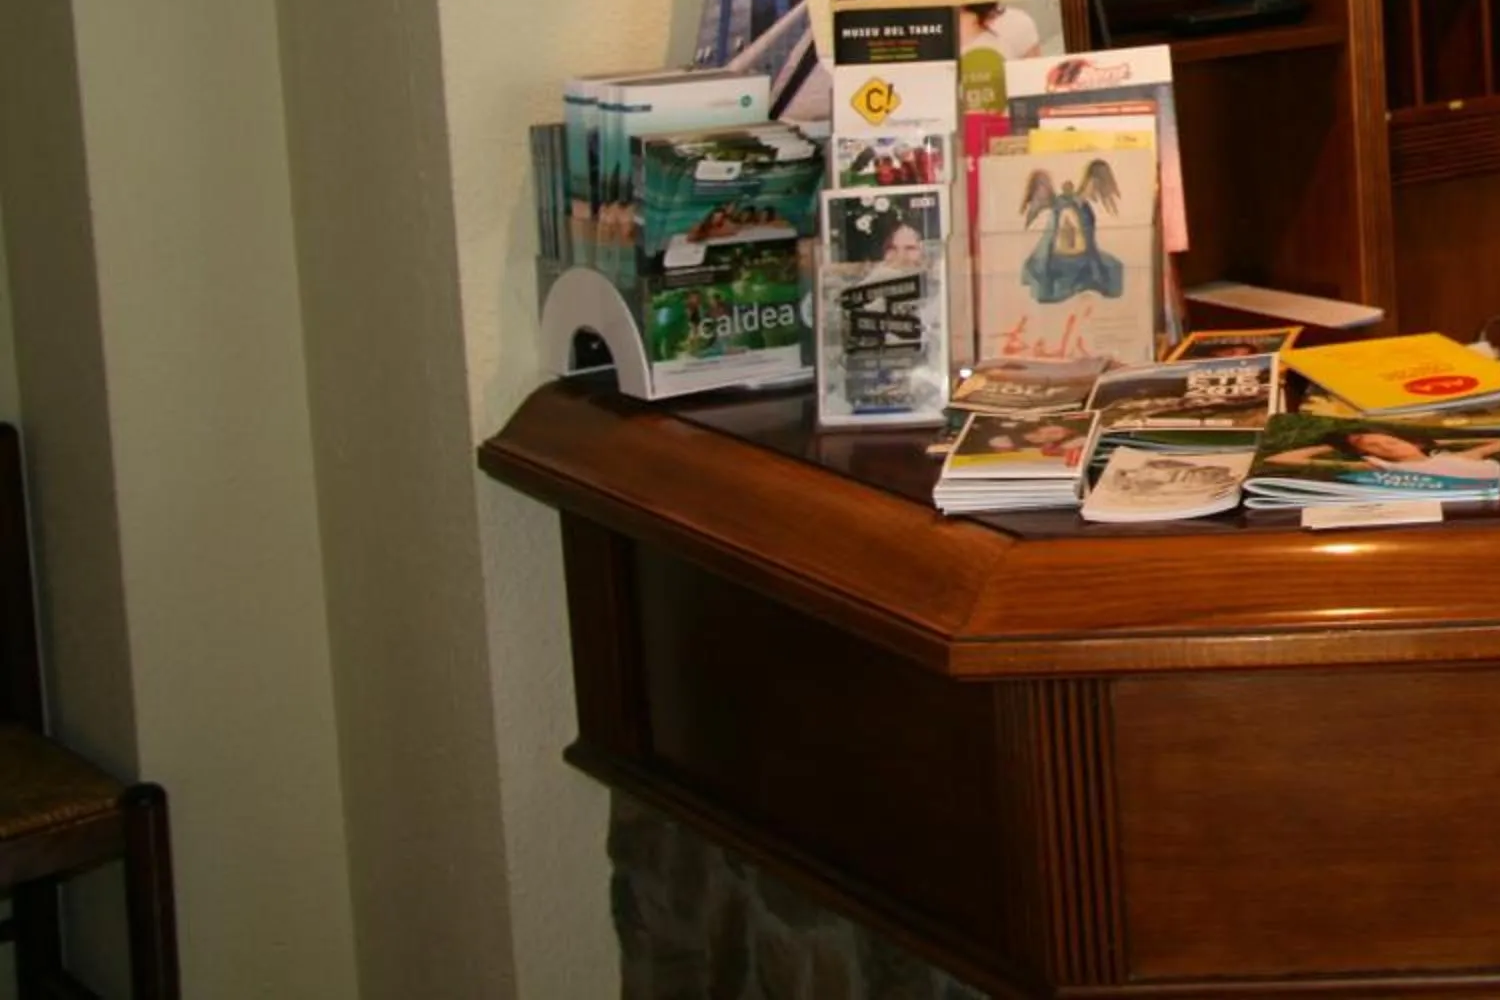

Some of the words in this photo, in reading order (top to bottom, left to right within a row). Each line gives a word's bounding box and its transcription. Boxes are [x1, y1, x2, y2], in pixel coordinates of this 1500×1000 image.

[842, 27, 880, 37] MUSEU
[883, 25, 906, 36] DEL
[700, 302, 796, 340] caldea
